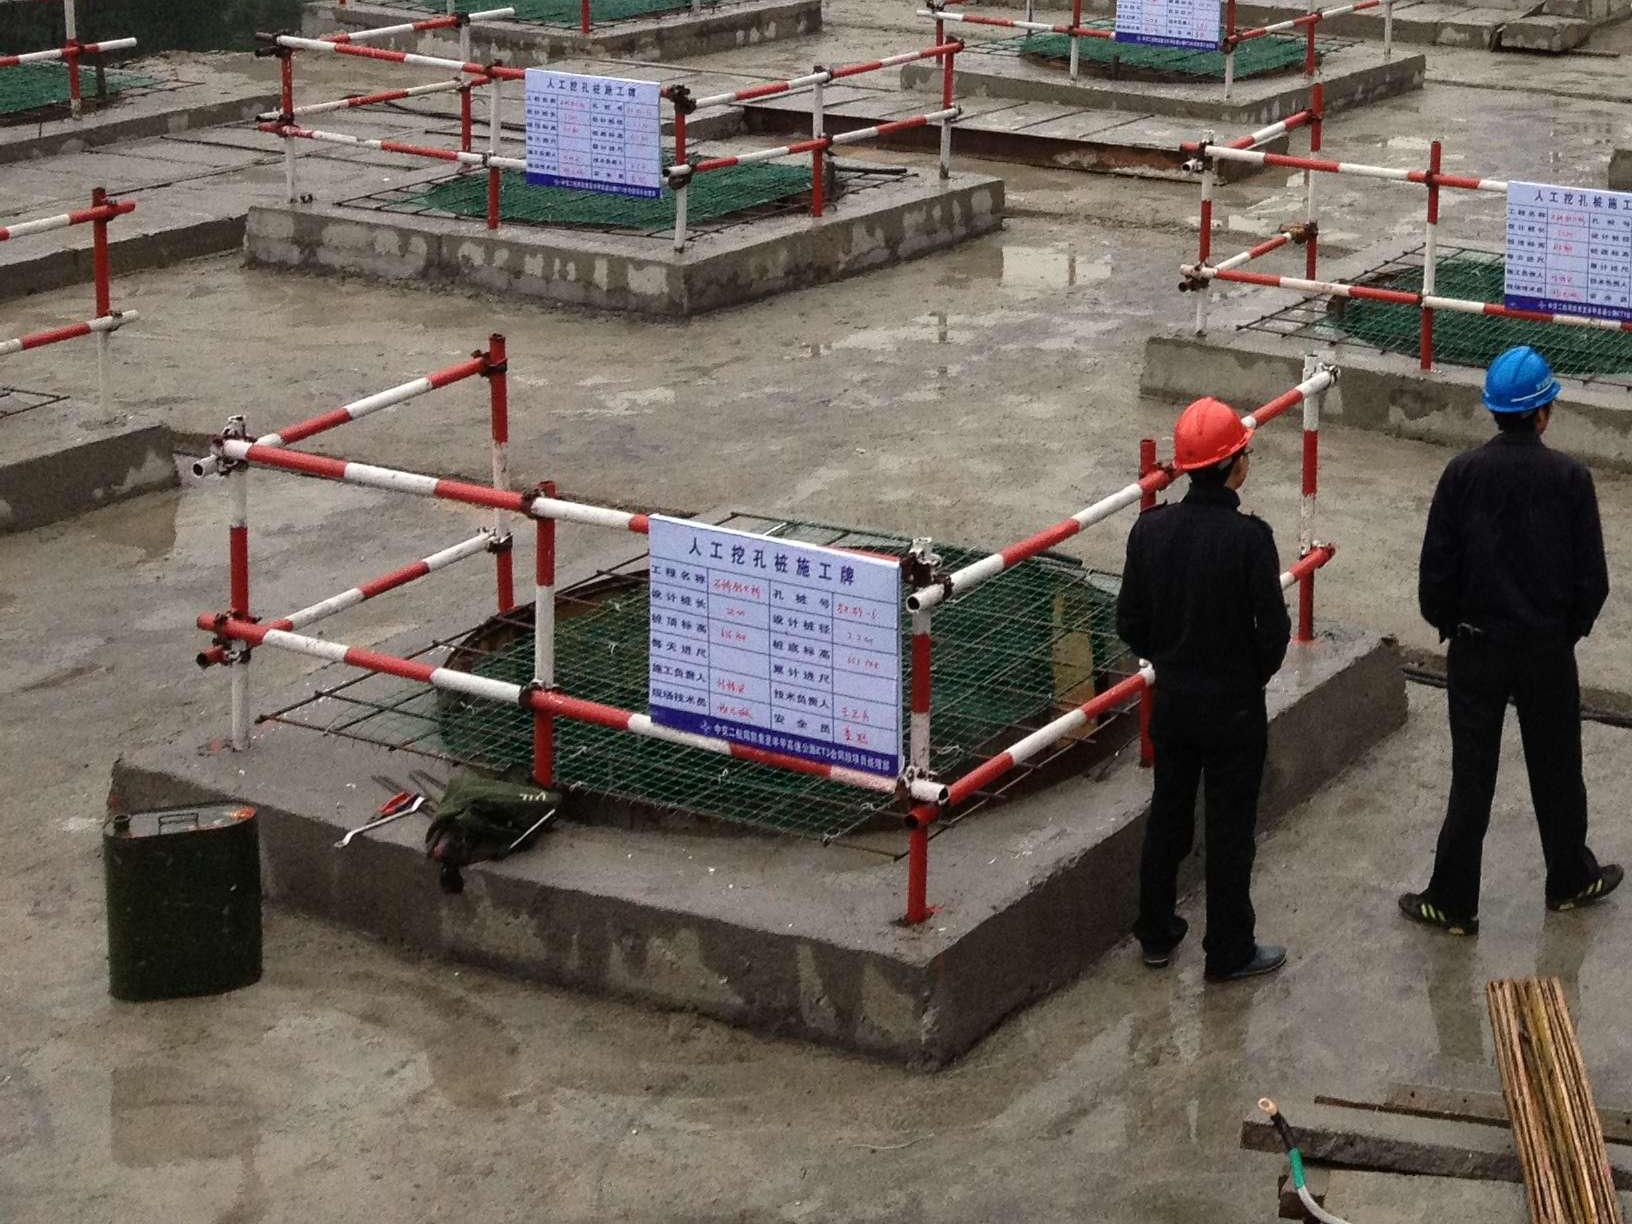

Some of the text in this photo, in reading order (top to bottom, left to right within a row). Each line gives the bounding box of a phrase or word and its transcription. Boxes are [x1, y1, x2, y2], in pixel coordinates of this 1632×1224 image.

[689, 537, 855, 586] 人工挖孔桩施工牌
[652, 564, 706, 584] 工程名称
[773, 588, 830, 610] 孔桩号
[772, 614, 830, 634] 设计桩径
[773, 664, 830, 684] 累计进尺
